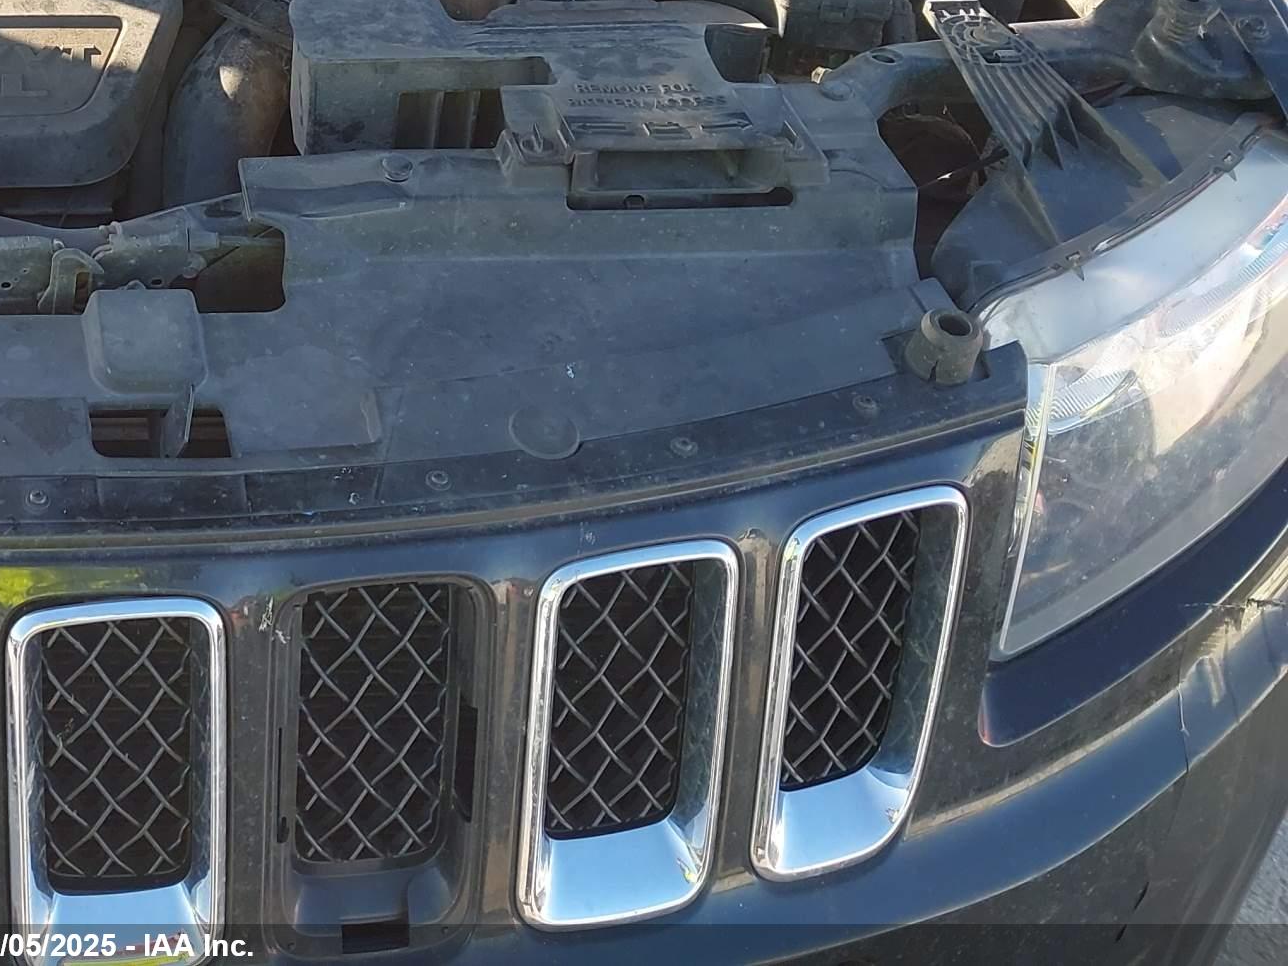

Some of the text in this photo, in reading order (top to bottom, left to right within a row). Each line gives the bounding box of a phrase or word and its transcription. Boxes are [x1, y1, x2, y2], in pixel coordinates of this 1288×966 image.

[573, 81, 700, 95] REMOVE FOR
[567, 97, 650, 109] BATTERY
